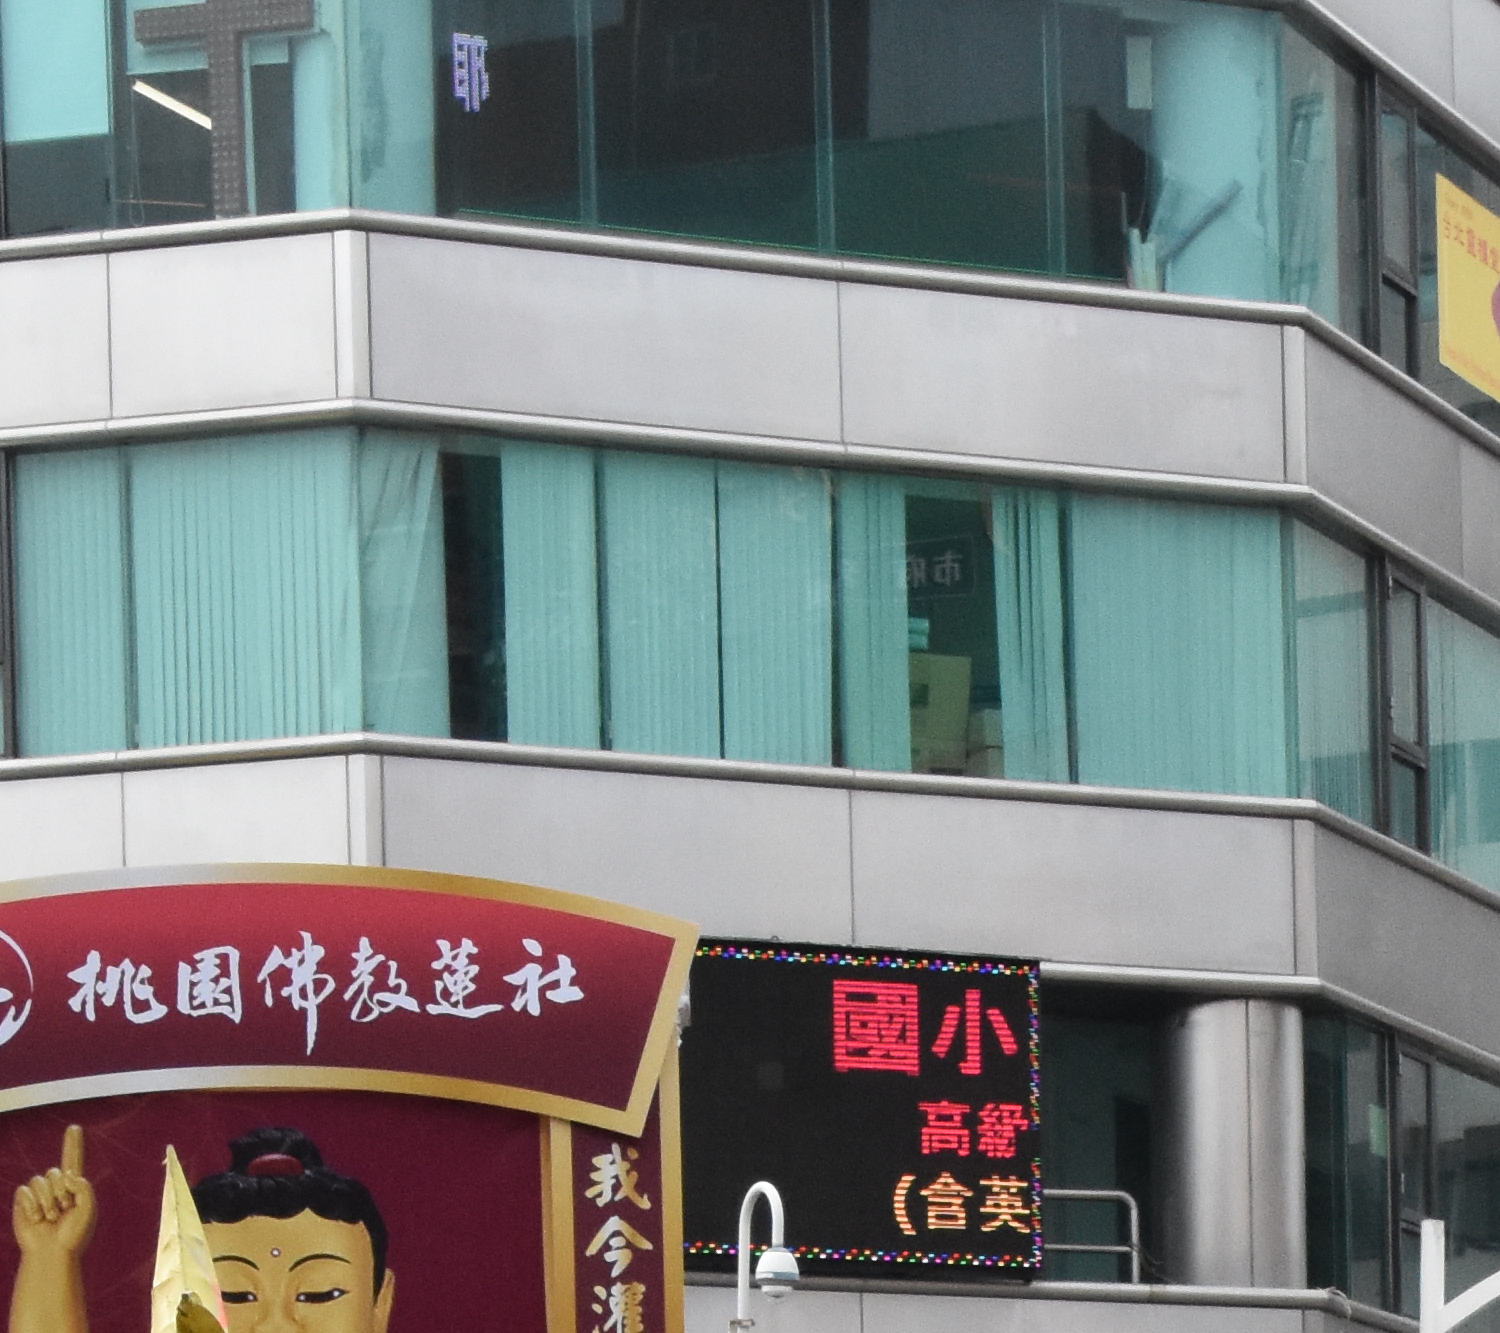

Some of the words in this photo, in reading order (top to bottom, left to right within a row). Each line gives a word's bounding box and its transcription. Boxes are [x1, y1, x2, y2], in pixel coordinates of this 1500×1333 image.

[66, 931, 586, 1057] 桃園佛教蓮社
[832, 979, 1018, 1076] 國小
